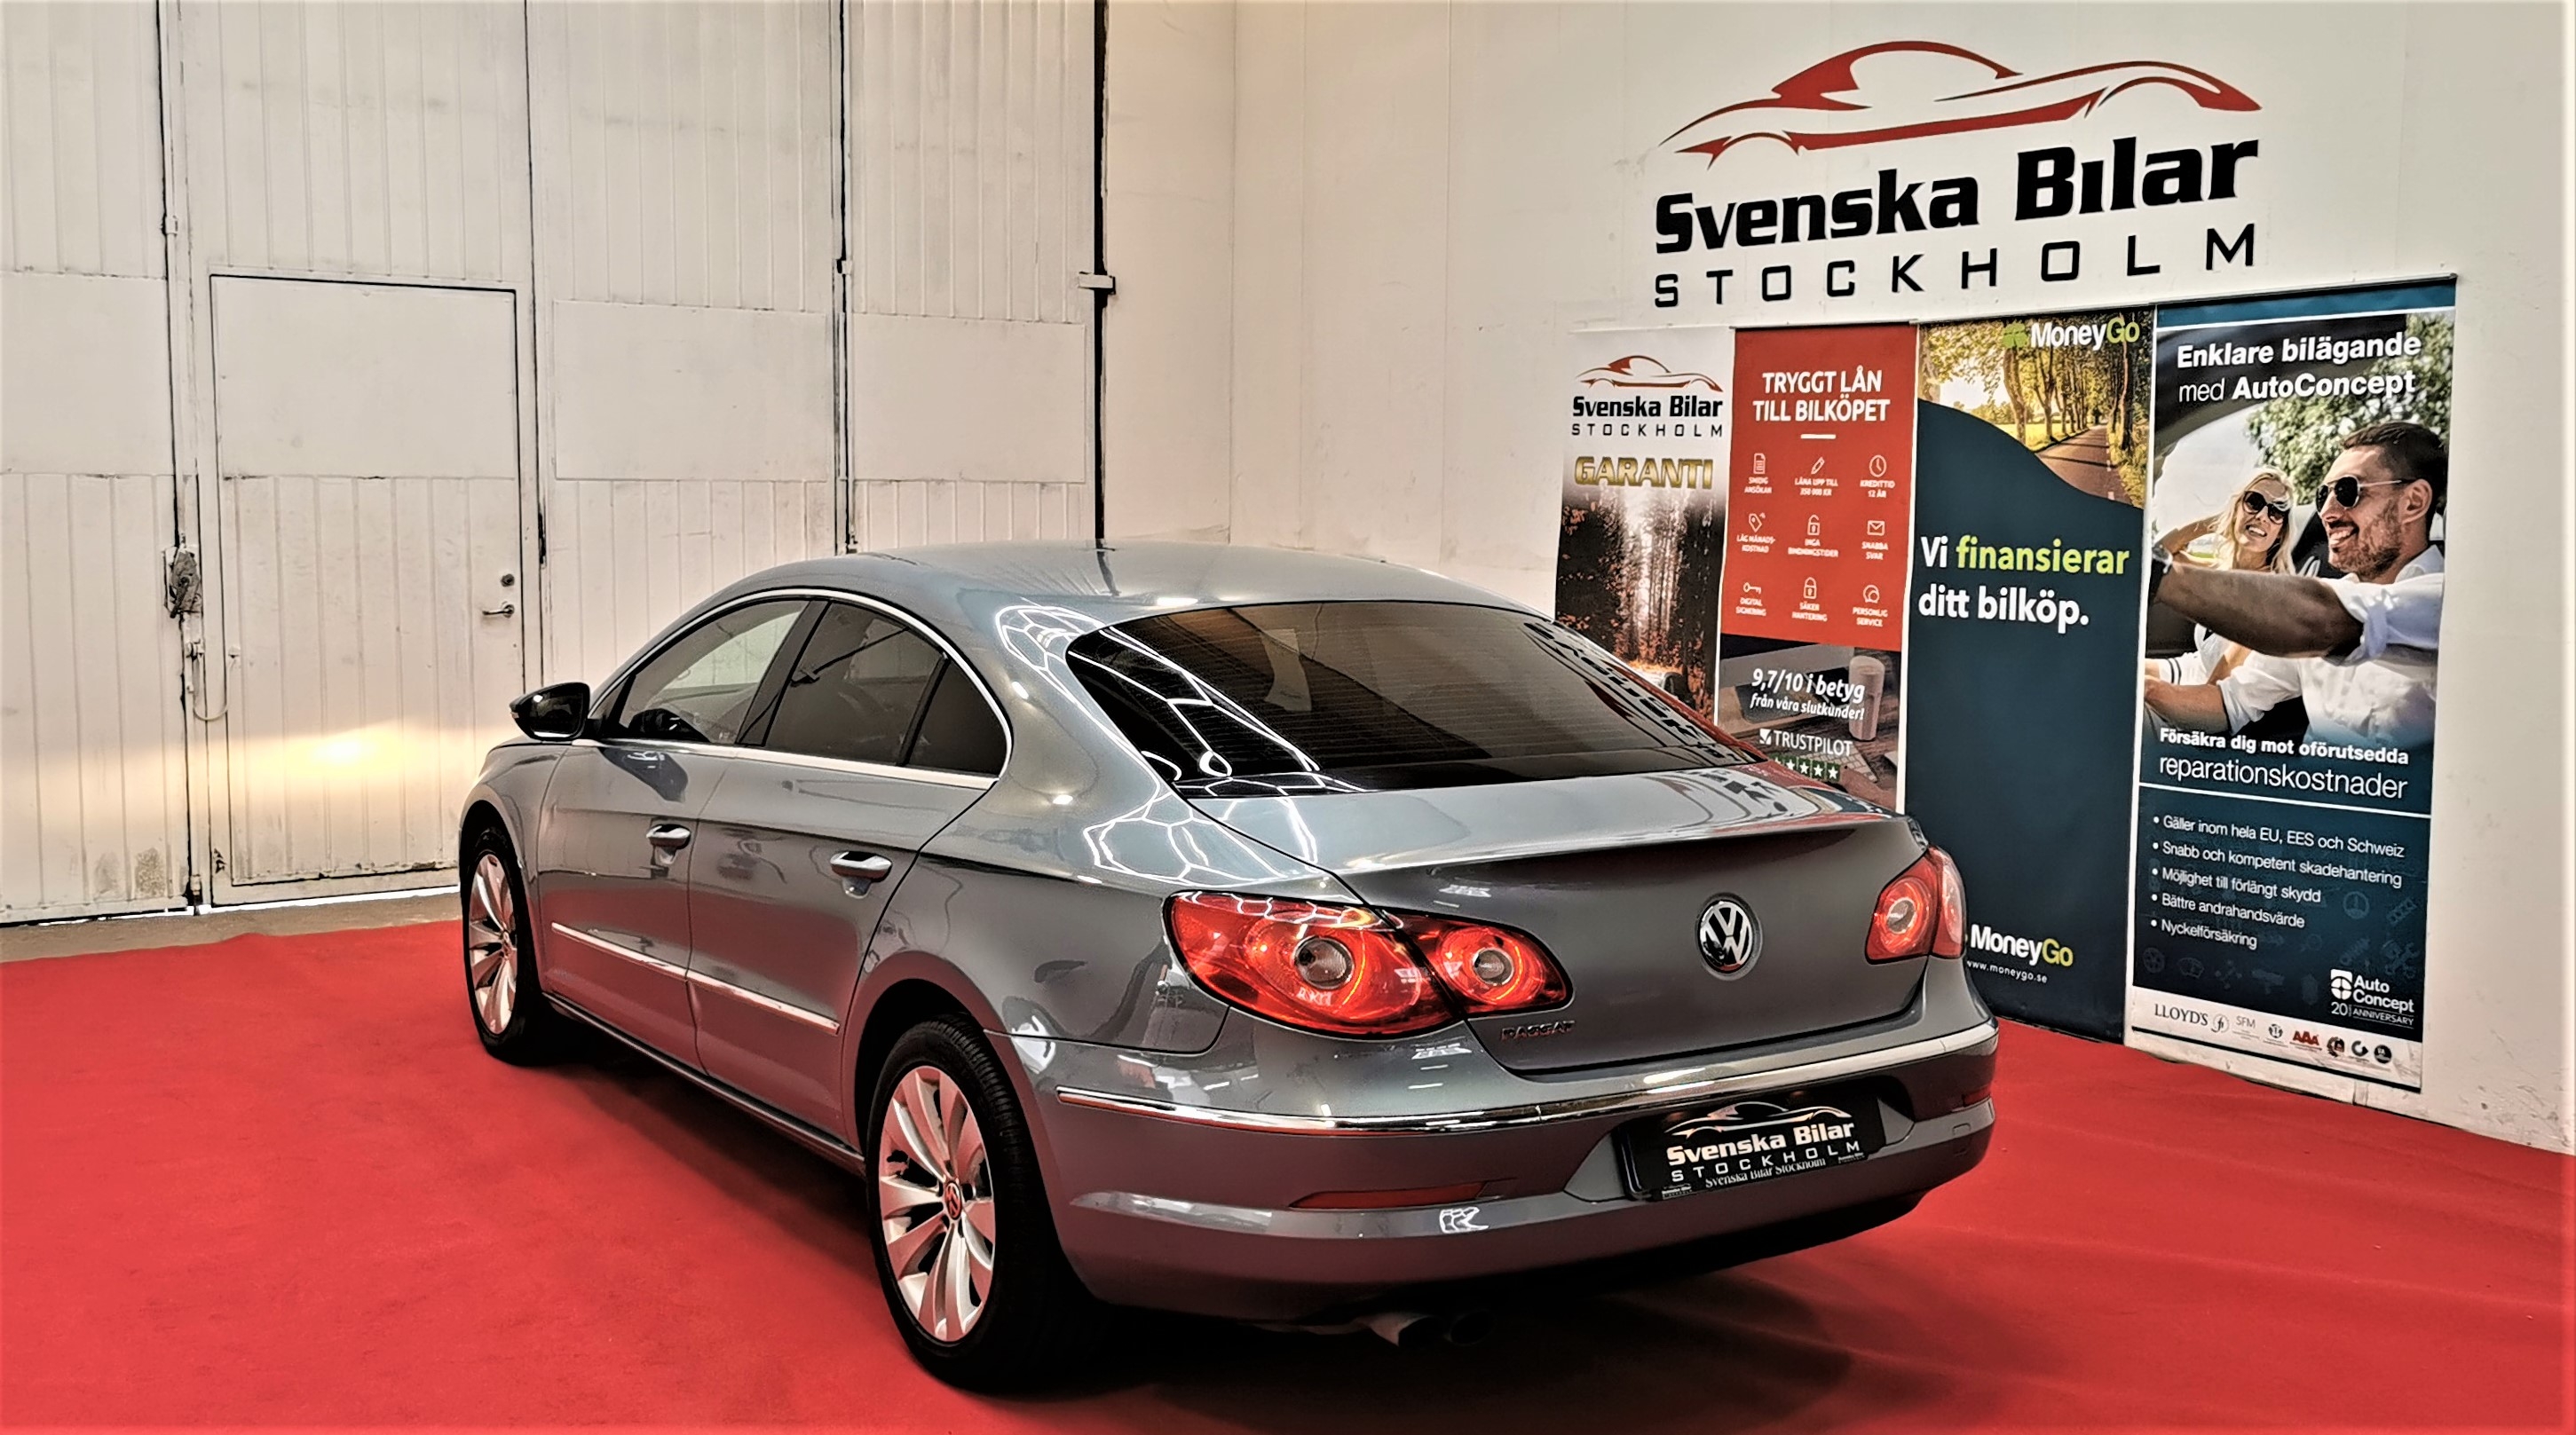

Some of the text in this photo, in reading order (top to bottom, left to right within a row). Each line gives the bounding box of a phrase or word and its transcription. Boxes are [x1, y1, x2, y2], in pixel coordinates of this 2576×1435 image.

[1655, 168, 1979, 254] Svenska
[1654, 223, 2255, 308] STOCKHOLM
[2030, 318, 2140, 351] MoneyGo
[2177, 332, 2421, 368] Enklare bilägande
[1762, 365, 1882, 394] TRYGGT LÅN
[2178, 370, 2416, 402] med AutoConcept
[1572, 396, 1723, 417] Svenska Bilar
[1752, 394, 1891, 422] TILL BILKÖPET
[1571, 423, 1723, 438] STOCKHOLM
[1574, 456, 1714, 490] GARANTI
[1921, 535, 2130, 575] Vi finansierar
[1918, 583, 2089, 634] ditt bilköp.
[1750, 668, 1865, 704] 9,7/10 i betyg
[1750, 693, 1865, 720] från våra slutkunder!
[1774, 730, 1853, 756] TRUSTPILOT
[2160, 728, 2408, 764] Försäkra dig mot oförutsedda
[2160, 756, 2408, 799] reparationskostnader
[2162, 816, 2405, 858] Gäller inom hela EU, EES och Schweiz
[2162, 841, 2402, 888] Snabb och kompetent skadehantering
[2162, 866, 2321, 903] Möjlighet till förlängt skydd
[2161, 893, 2305, 928] Bättre andrahandsvärde
[1971, 924, 2074, 966] MoneyGo
[2161, 919, 2257, 950] Nyckelförsäkring
[2353, 974, 2390, 993] Auto
[2353, 989, 2414, 1013] Concept
[2154, 1004, 2208, 1026] LLOYD'S
[2236, 1015, 2256, 1028] SFM
[2292, 1030, 2319, 1045] AAA
[2331, 1001, 2348, 1016] 20
[2352, 1008, 2414, 1026] ANNIVERSARY
[1666, 1123, 1854, 1166] Svenska Bilar
[1671, 1140, 1860, 1182] STOCKHOLM
[1705, 1172, 1748, 1188] Svenska
